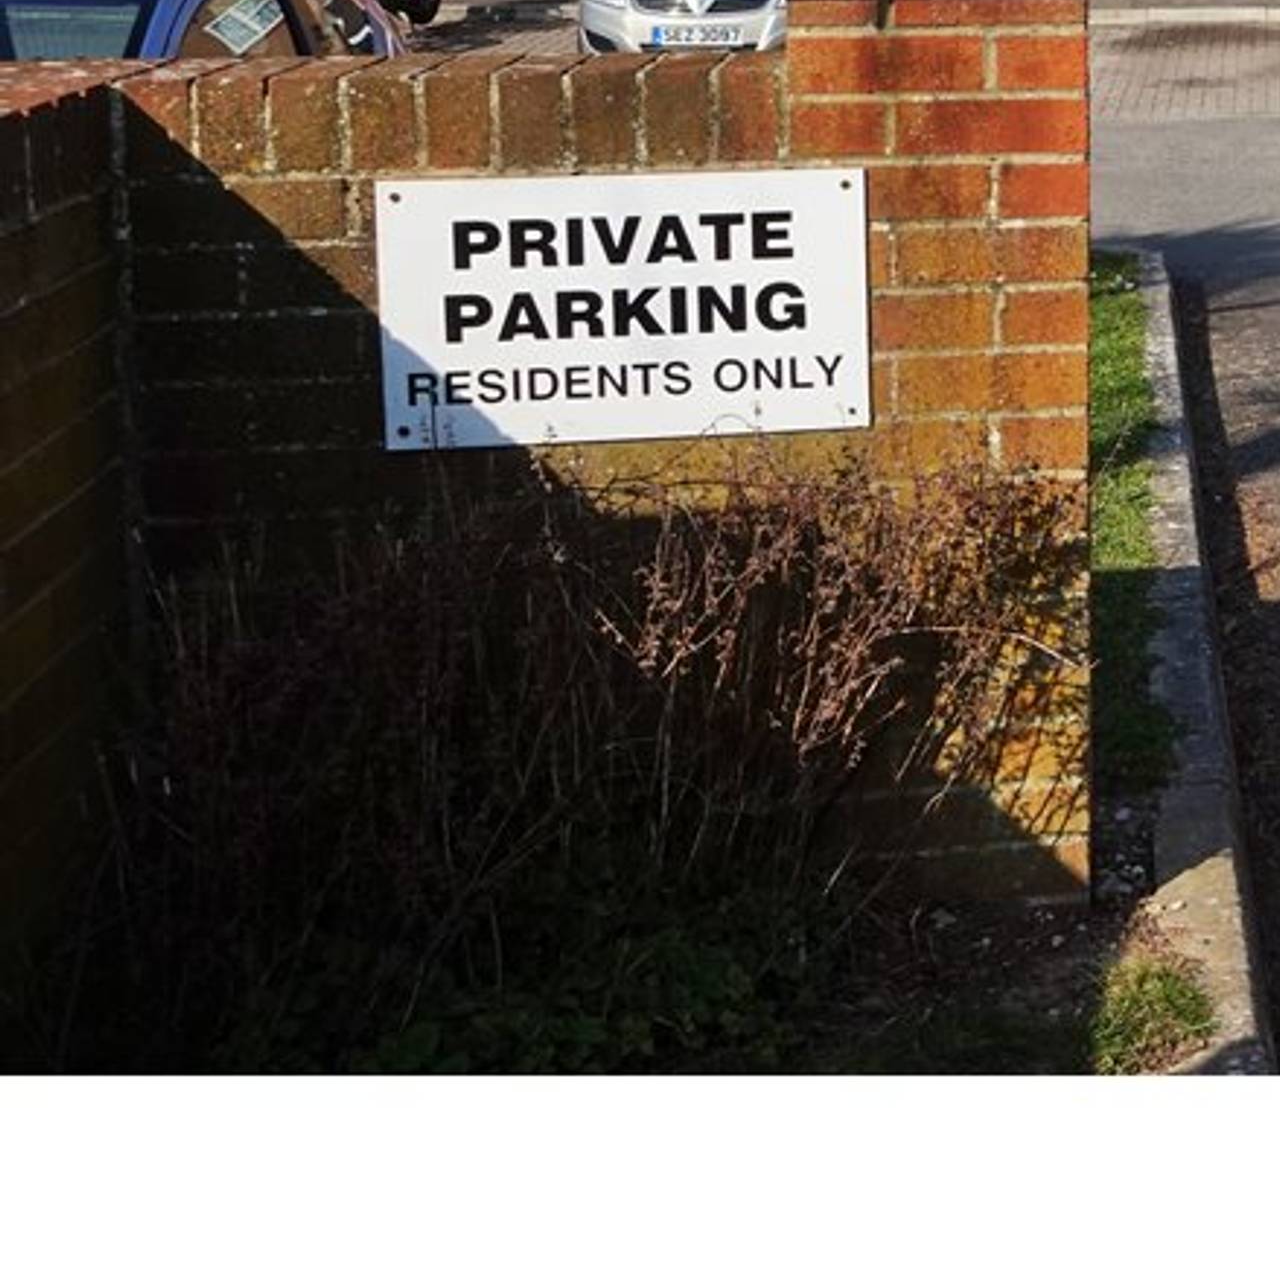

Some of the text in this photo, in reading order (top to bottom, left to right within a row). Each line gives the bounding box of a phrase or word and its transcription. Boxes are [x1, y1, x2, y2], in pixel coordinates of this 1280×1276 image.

[663, 27, 693, 42] SEZ
[451, 210, 795, 270] PRIVATE
[443, 281, 807, 343] PARKING
[407, 355, 843, 407] RESIDENTS ONLY
